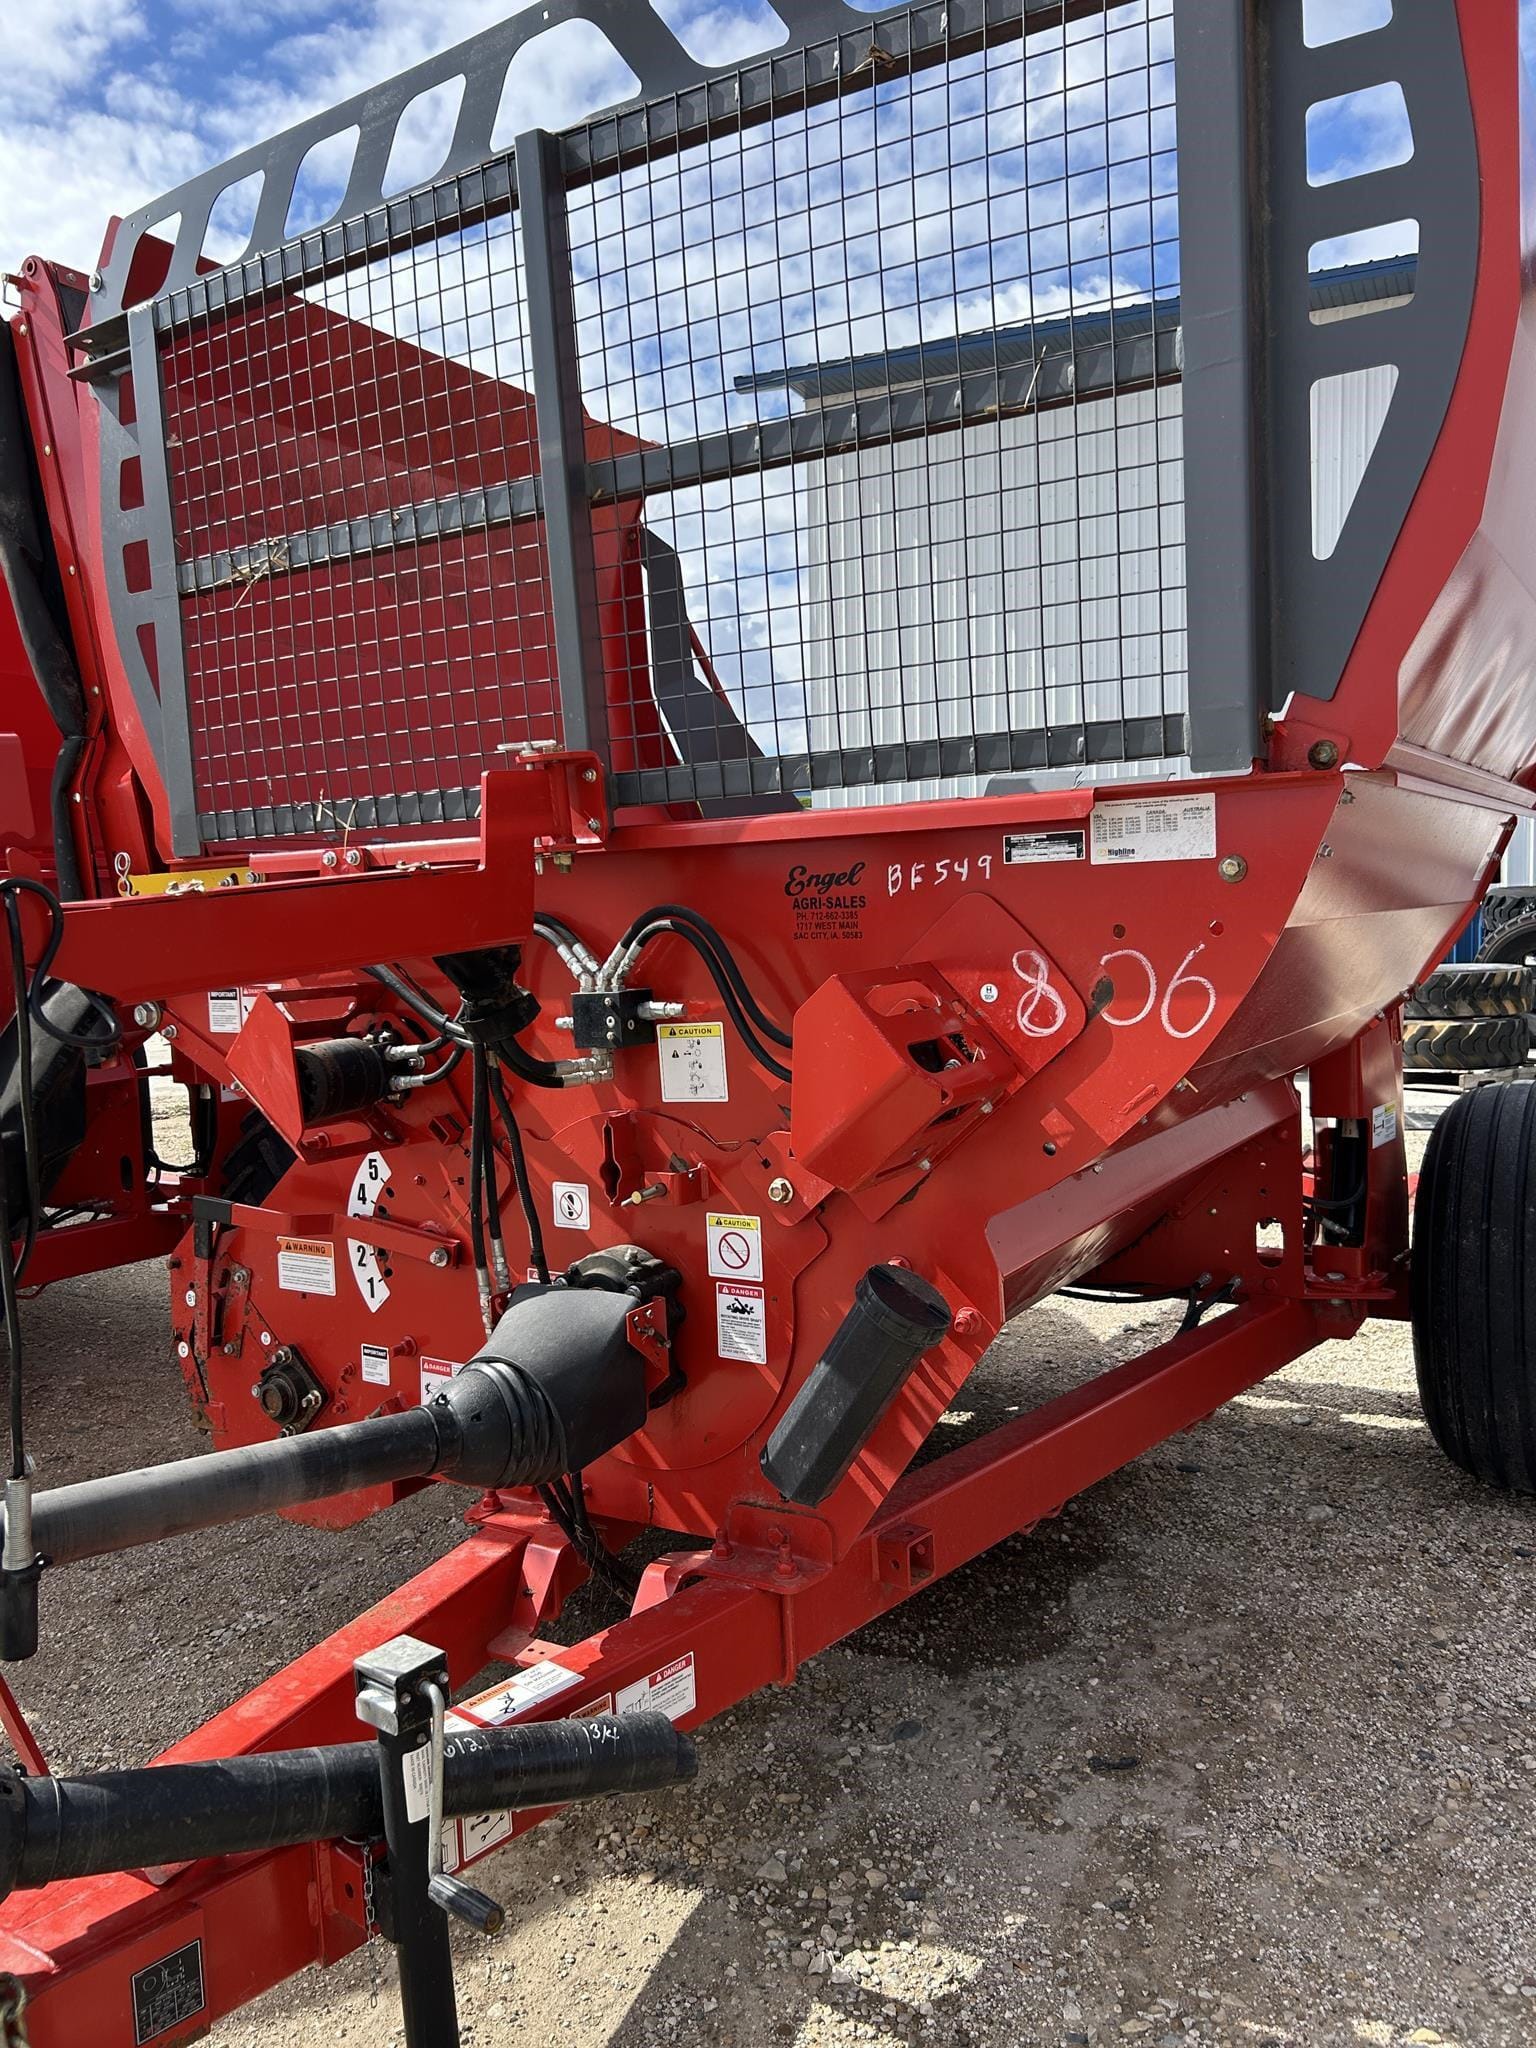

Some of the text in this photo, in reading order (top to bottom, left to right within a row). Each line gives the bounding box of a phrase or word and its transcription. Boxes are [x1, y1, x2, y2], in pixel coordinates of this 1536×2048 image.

[1107, 848, 1135, 856] Highline
[784, 861, 866, 896] Engel
[793, 895, 867, 910] AGRI-SALES
[797, 921, 859, 931] 1717 WEST MAIN
[793, 932, 809, 940] SAC
[841, 931, 863, 939] 50583
[368, 1158, 379, 1181] 5
[357, 1183, 367, 1205] 4
[723, 1219, 751, 1227] CAUTION
[292, 1242, 326, 1254] WARNING
[357, 1245, 367, 1267] 2
[366, 1276, 375, 1299] 1
[730, 1288, 759, 1297] DANGER
[363, 1348, 387, 1357] IMPORTANT
[428, 1363, 451, 1373] DANGER
[663, 1659, 687, 1678] DANGER
[477, 1683, 511, 1702] WARNING
[581, 1701, 607, 1719] WARNING
